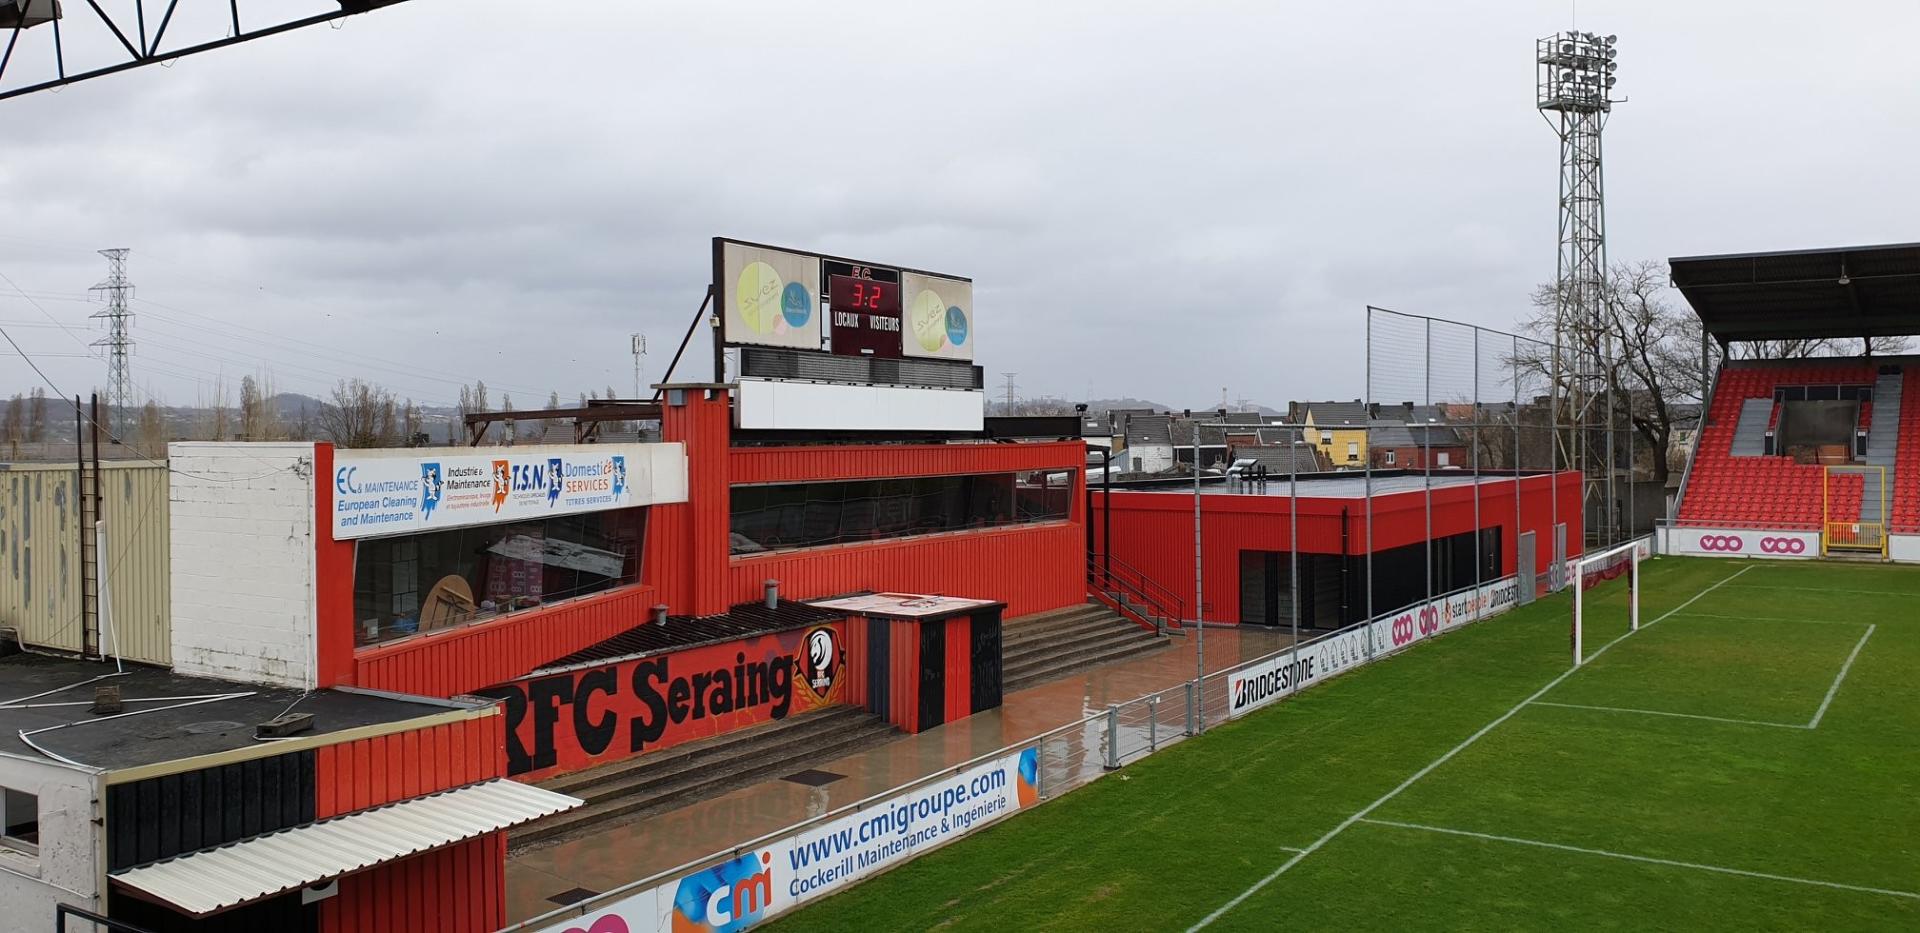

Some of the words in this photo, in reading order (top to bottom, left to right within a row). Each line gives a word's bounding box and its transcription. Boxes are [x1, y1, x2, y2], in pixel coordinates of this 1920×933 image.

[852, 284, 881, 308] 3:2
[834, 311, 859, 328] LOCAUX
[869, 315, 900, 332] VISITEURS
[336, 466, 357, 494] EC
[364, 480, 419, 494] MAINTENANCE
[448, 466, 479, 477] Industrie
[512, 464, 547, 491] T.S.N.
[446, 479, 491, 490] Maintenance
[566, 478, 609, 493] SERVICES
[338, 499, 380, 512] European
[382, 496, 417, 508] Cleaning
[586, 495, 612, 505] SERVICES
[341, 514, 359, 527] and
[360, 511, 414, 525] Maintenance
[477, 665, 618, 778] RFC
[630, 651, 794, 753] Seraing
[788, 767, 1006, 871] www.cmigroupe.com
[789, 855, 853, 897] Cockerill
[857, 824, 938, 871] Maintenance
[940, 818, 950, 833] &
[952, 795, 1007, 829] Ingénierie
[706, 851, 772, 927] cmi
